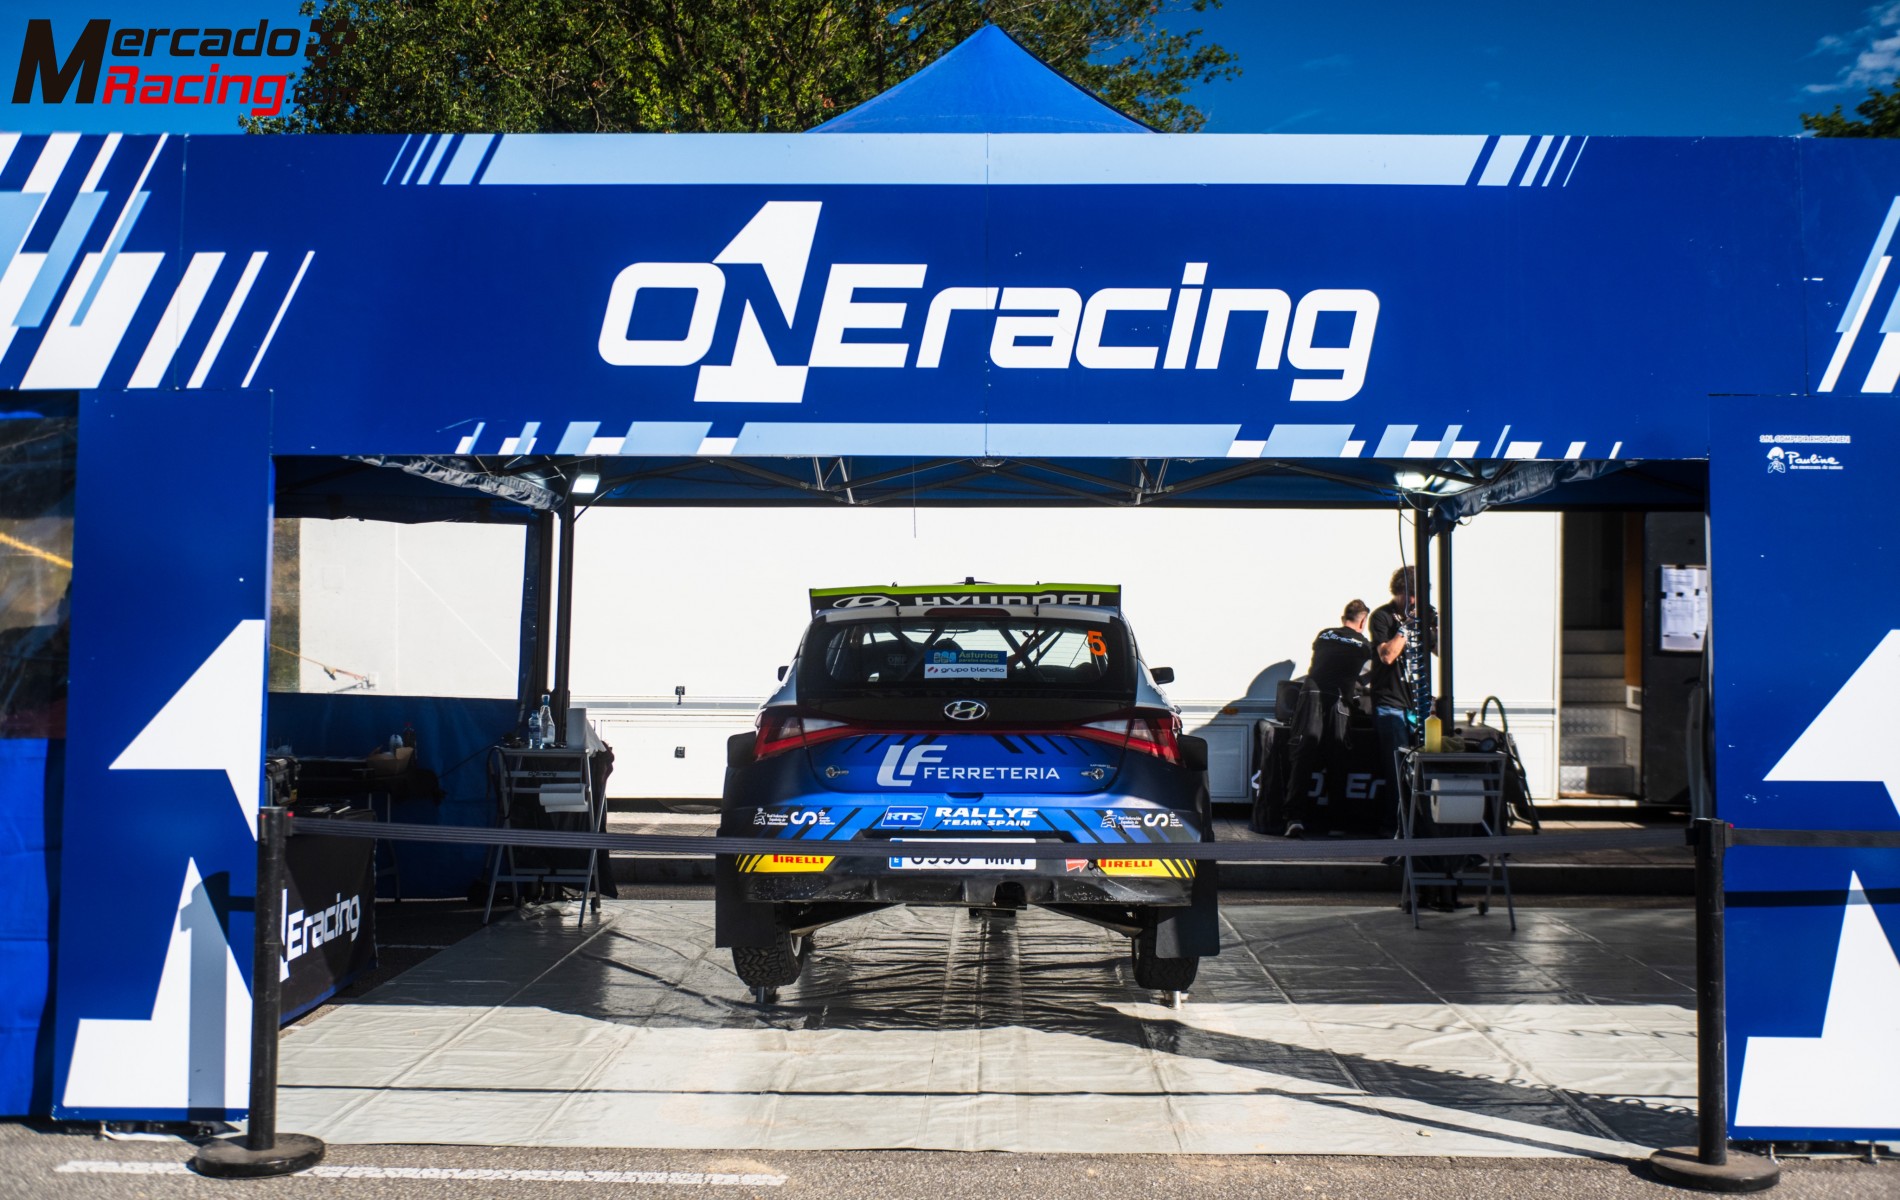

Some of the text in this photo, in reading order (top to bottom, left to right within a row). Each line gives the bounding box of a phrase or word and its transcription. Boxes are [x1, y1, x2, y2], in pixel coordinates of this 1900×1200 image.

[1784, 451, 1840, 465] Pauline
[1087, 630, 1108, 656] 5
[940, 666, 969, 674] grupo
[923, 767, 1061, 780] FERRETERIA
[886, 812, 923, 821] RTS
[934, 807, 1039, 818] RALLYE
[987, 819, 1031, 827] SPAIN
